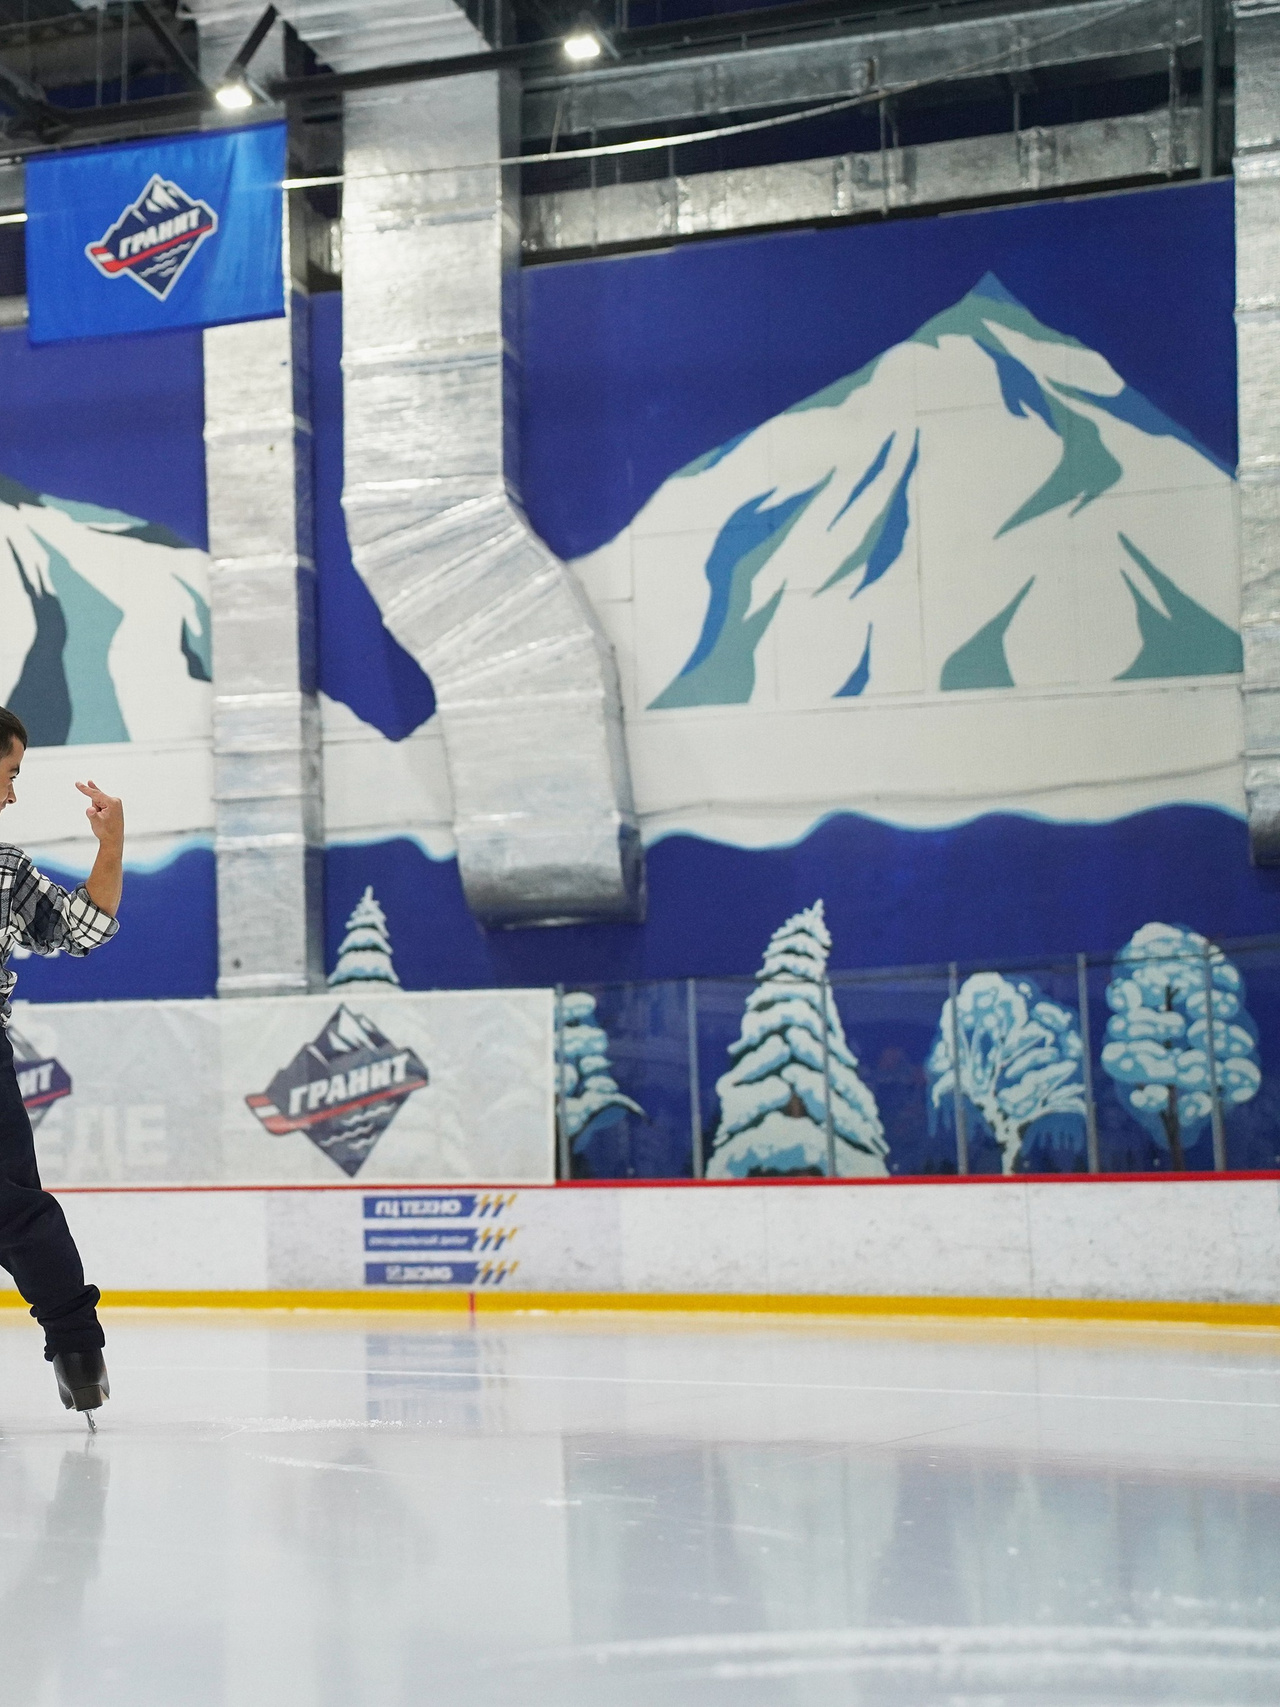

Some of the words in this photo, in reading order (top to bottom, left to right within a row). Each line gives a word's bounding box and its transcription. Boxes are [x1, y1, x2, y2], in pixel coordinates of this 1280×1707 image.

[119, 207, 201, 259] ГРАНИТ
[289, 1052, 411, 1116] ГРАНИТ
[401, 1199, 463, 1215] ТЕХНО
